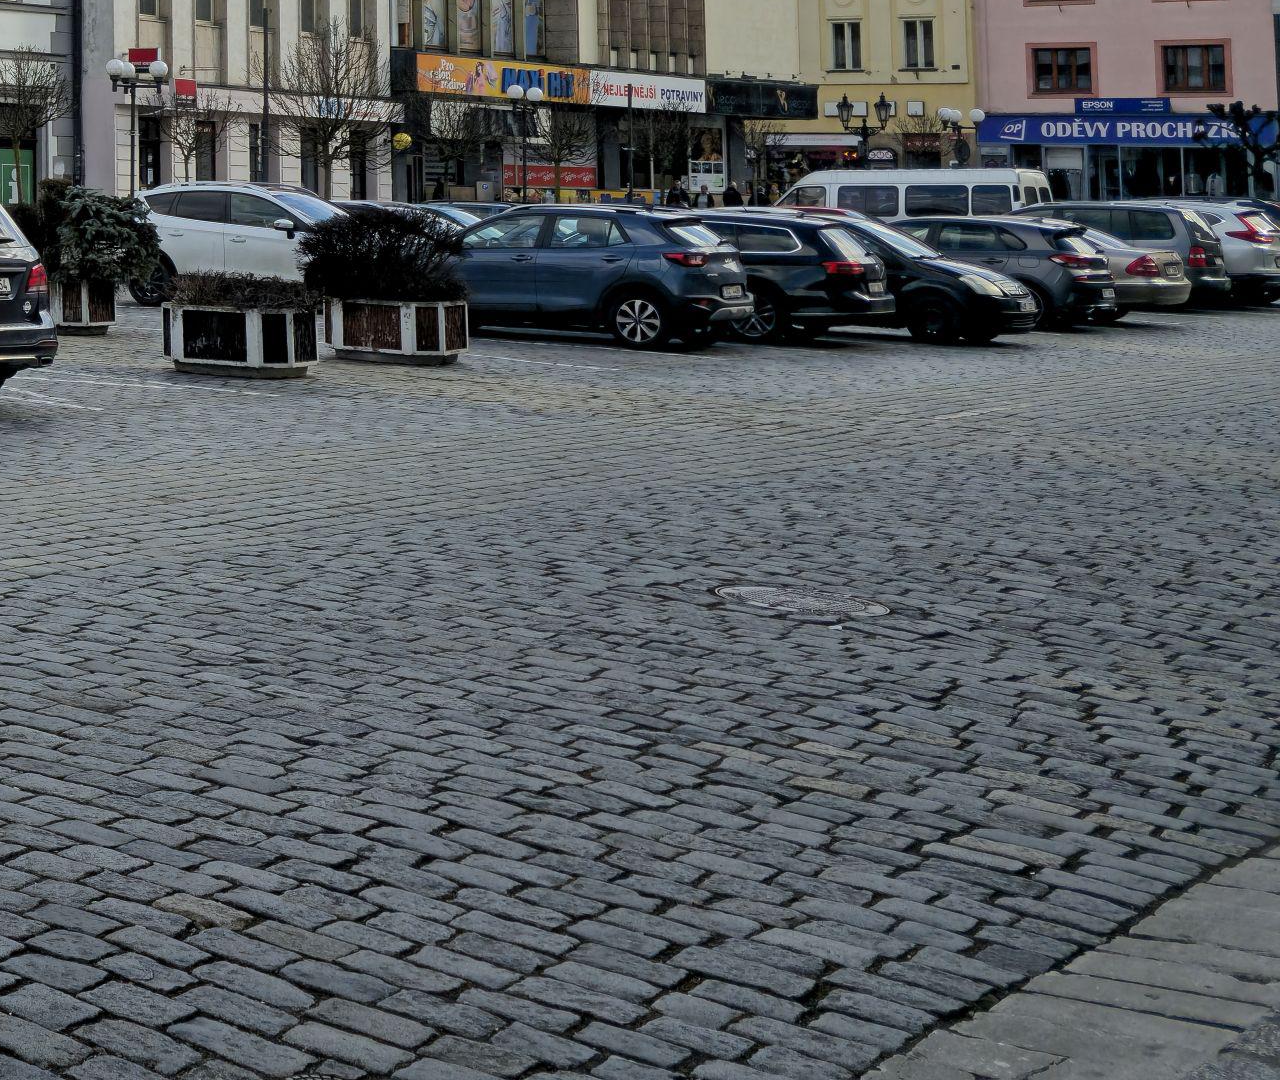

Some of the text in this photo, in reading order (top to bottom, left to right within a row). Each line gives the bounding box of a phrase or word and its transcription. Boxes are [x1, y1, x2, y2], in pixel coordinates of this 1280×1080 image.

[660, 88, 704, 103] POTRAVINY
[1082, 101, 1114, 109] EPSON
[1004, 122, 1022, 134] OP
[1041, 118, 1110, 138] ODĚVY
